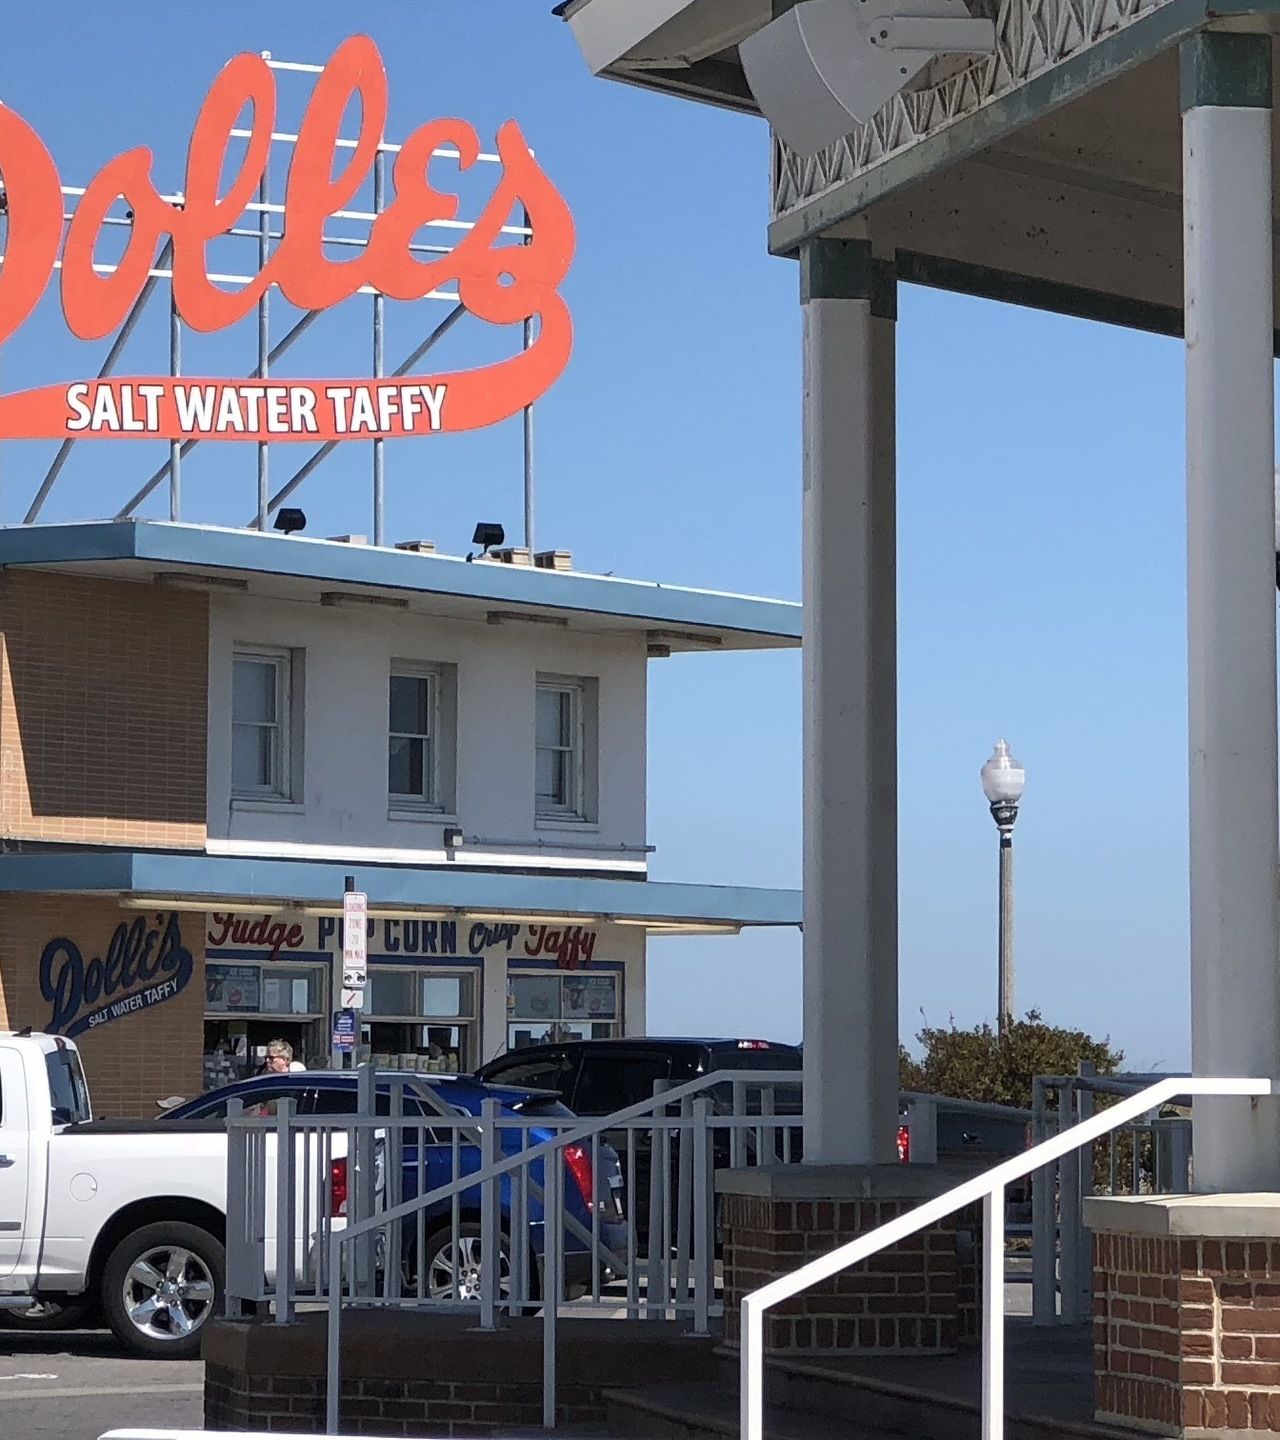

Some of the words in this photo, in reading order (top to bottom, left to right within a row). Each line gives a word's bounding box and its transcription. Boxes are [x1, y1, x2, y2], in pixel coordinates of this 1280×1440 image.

[66, 383, 164, 432] SALT
[173, 384, 320, 433] WATER
[325, 384, 448, 433] TAFFY
[208, 912, 304, 961] Fudge
[524, 924, 597, 970] Taffy
[88, 1009, 110, 1028] SALT
[111, 993, 145, 1018] WATER
[144, 978, 178, 1006] TAFFY
